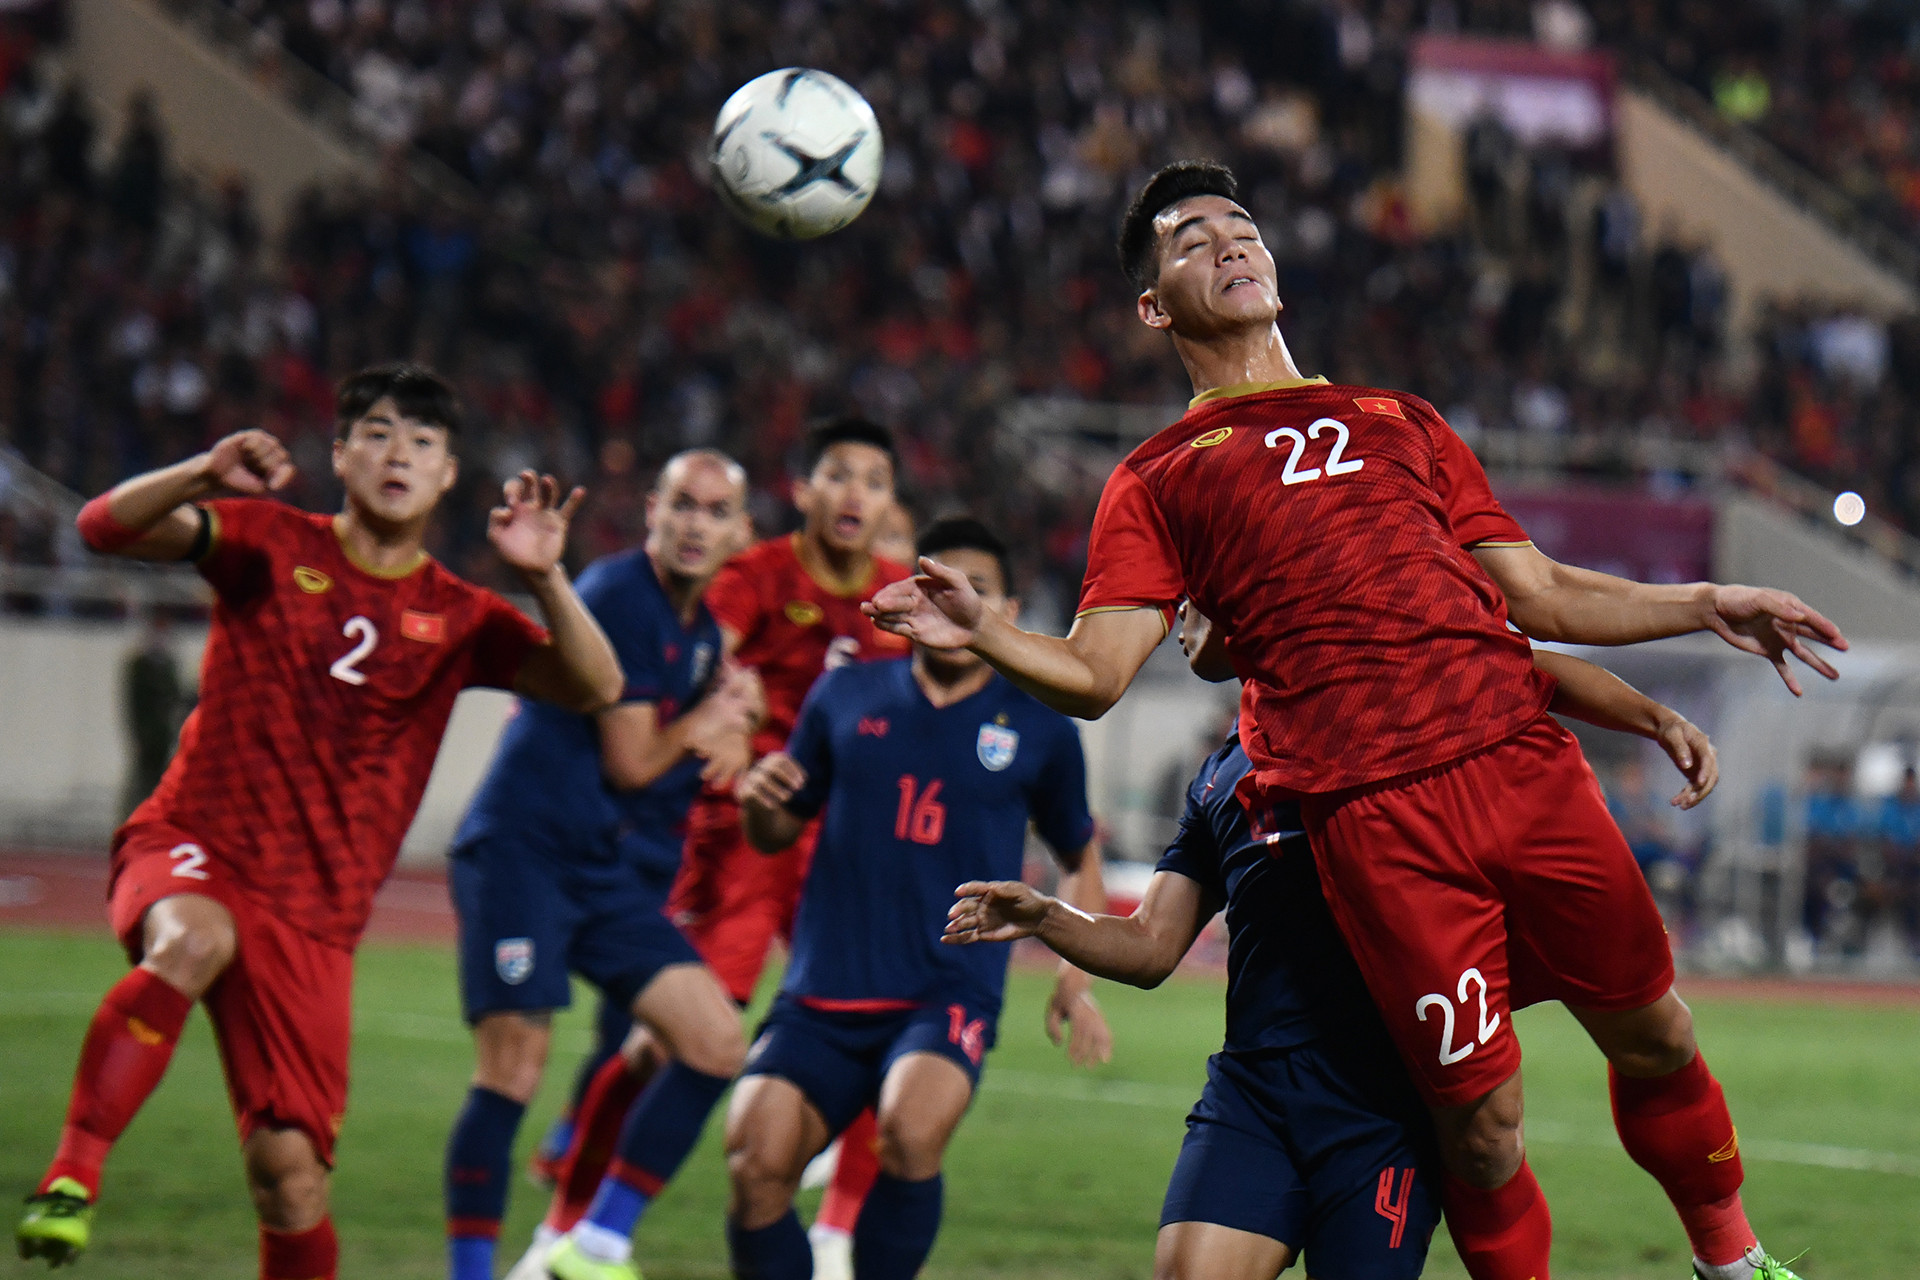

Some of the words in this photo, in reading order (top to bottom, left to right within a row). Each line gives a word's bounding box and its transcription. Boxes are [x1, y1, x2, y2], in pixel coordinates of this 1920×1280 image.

[1264, 417, 1364, 486] 22
[329, 615, 379, 686] 2
[894, 773, 946, 845] 16
[169, 842, 209, 880] 2
[1416, 967, 1500, 1066] 22
[1375, 1167, 1415, 1248] 4
